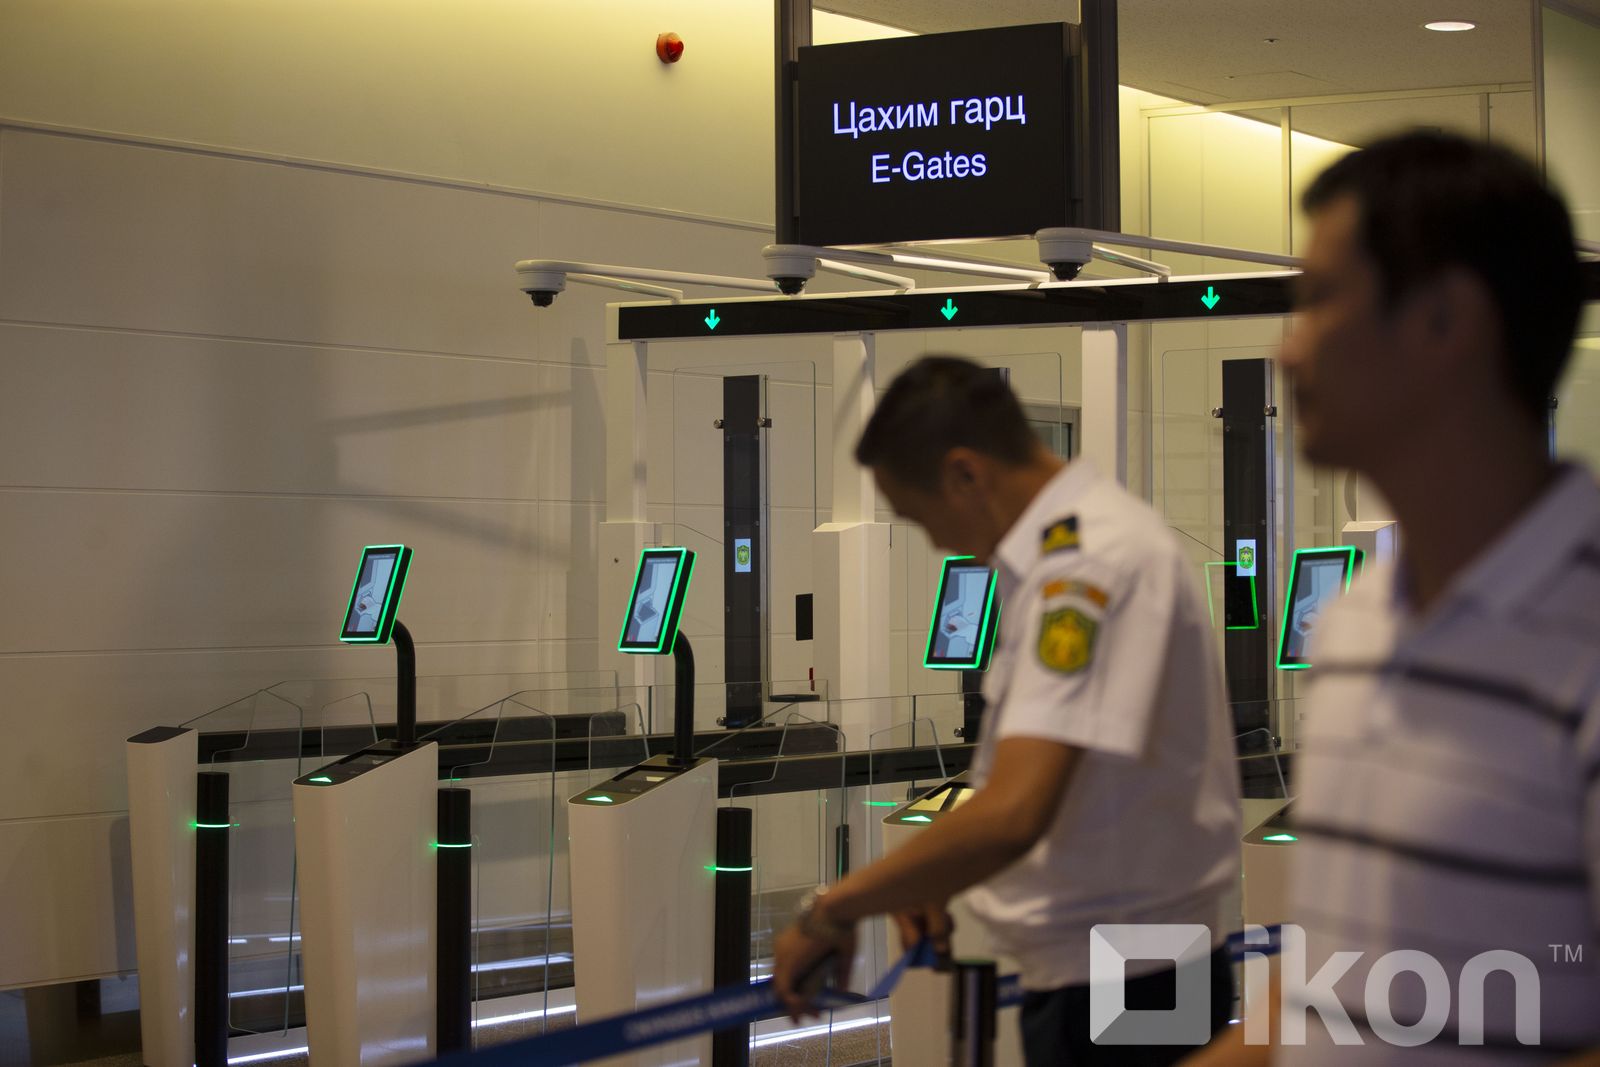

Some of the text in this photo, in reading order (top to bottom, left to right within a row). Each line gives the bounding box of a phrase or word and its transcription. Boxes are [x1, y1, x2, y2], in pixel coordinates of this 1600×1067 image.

[833, 95, 1026, 139] Цахим гарц
[871, 150, 988, 183] E-Gates
